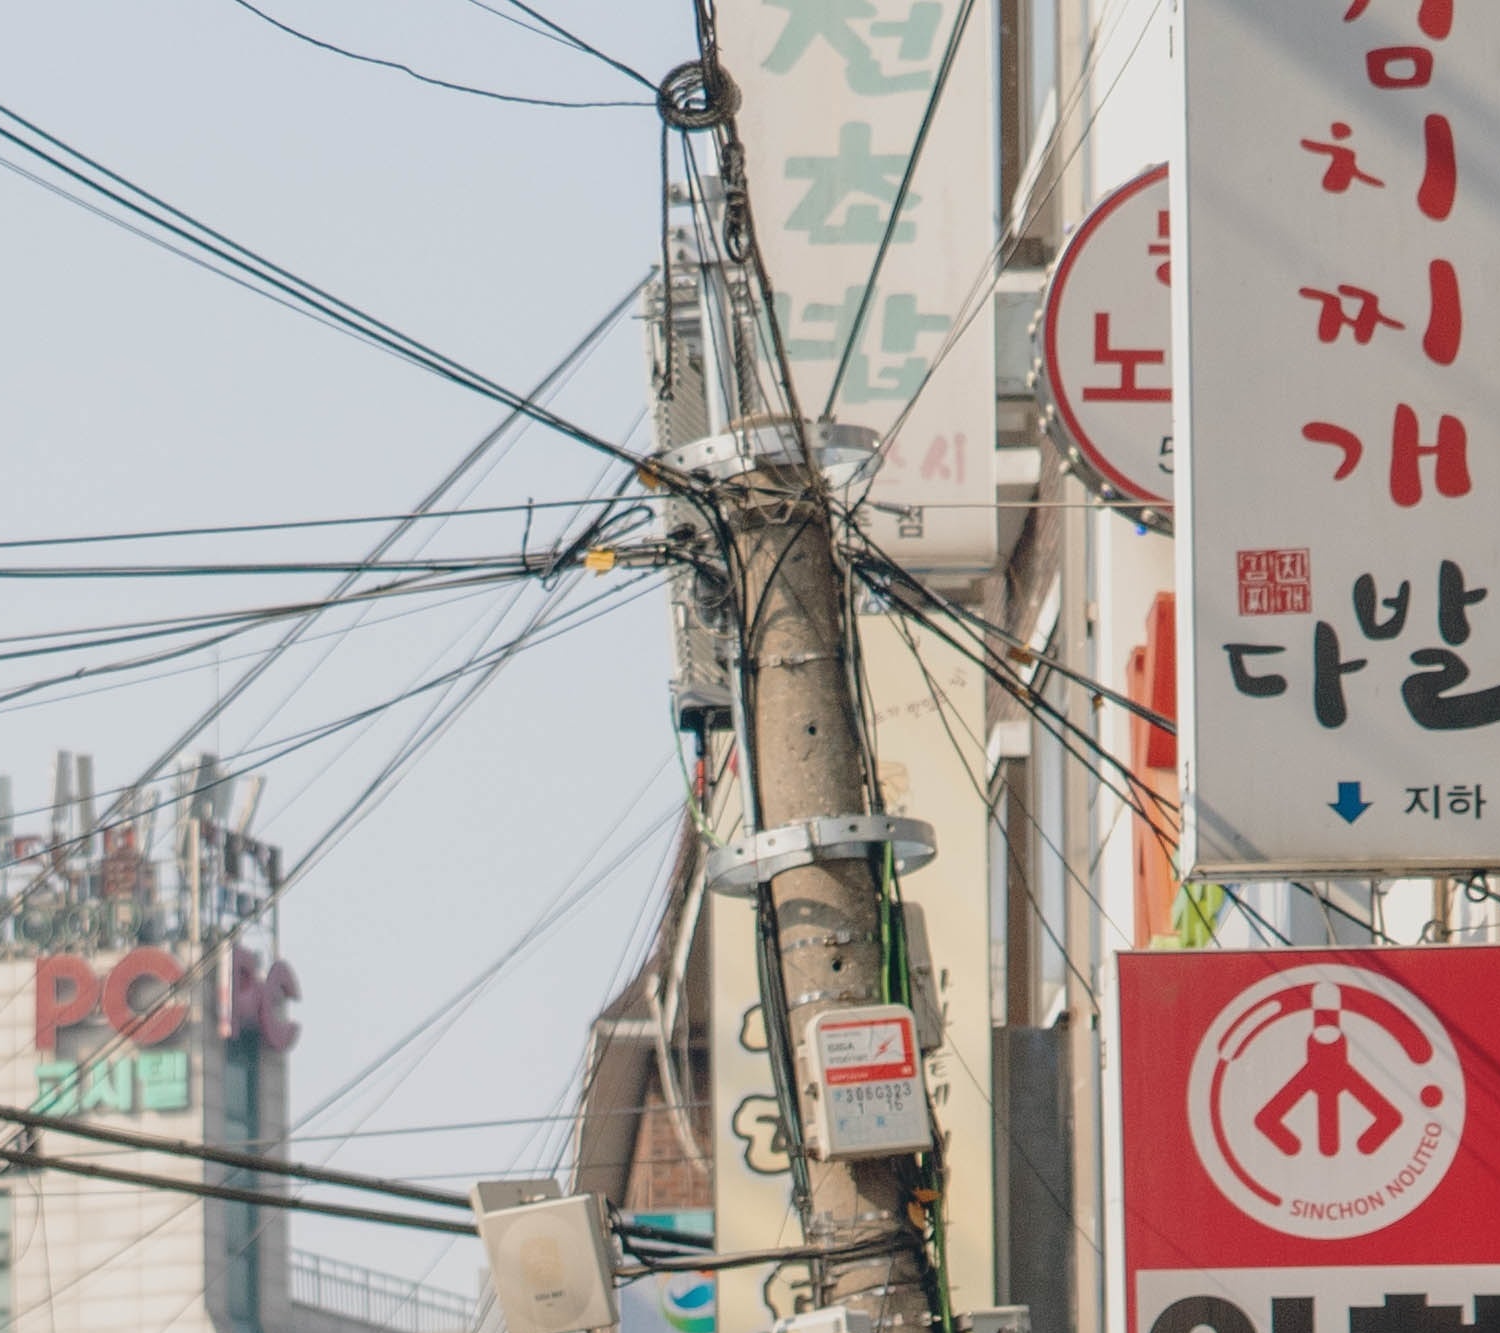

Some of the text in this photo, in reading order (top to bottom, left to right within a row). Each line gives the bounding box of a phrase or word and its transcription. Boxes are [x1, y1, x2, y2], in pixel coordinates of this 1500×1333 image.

[1403, 781, 1488, 820] 지하
[35, 946, 190, 1050] PC
[1289, 1119, 1443, 1222] SINCHON NOLITEO
